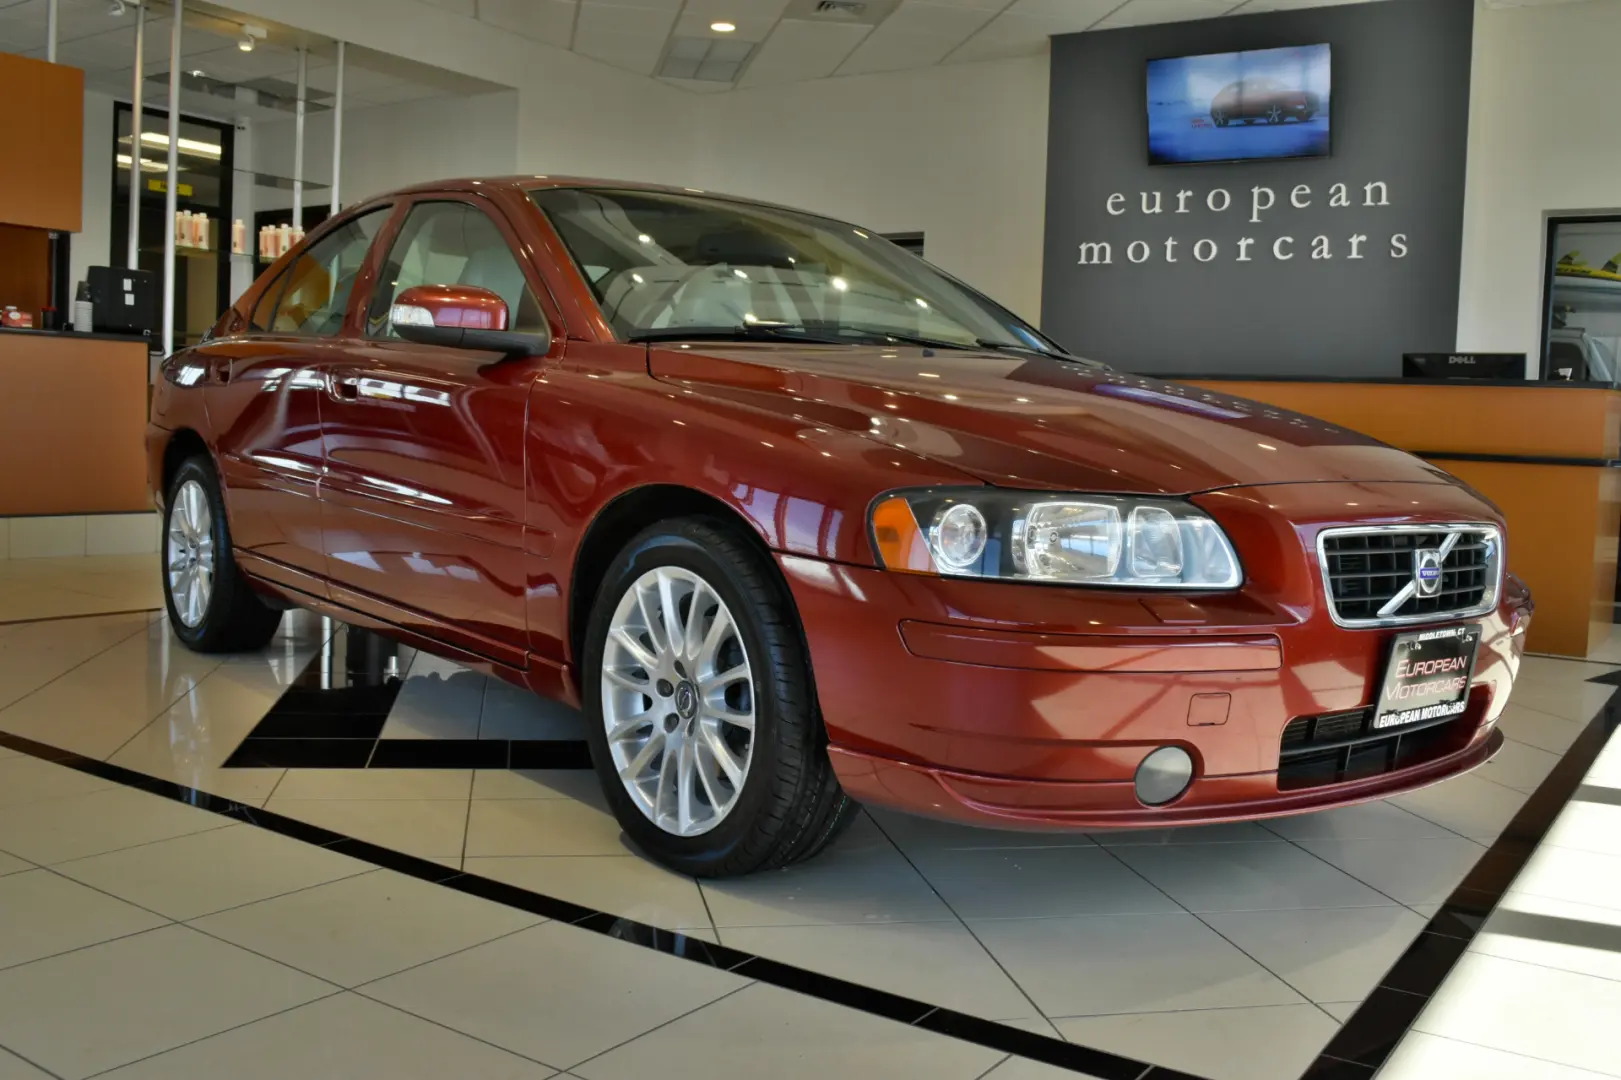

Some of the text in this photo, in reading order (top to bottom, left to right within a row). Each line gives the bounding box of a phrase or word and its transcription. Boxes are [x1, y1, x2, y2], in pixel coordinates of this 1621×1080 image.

[1106, 180, 1390, 222] european
[1077, 233, 1408, 265] motorcars
[1395, 655, 1468, 678] EUROPEAN
[1386, 676, 1468, 701] MOTORCARS
